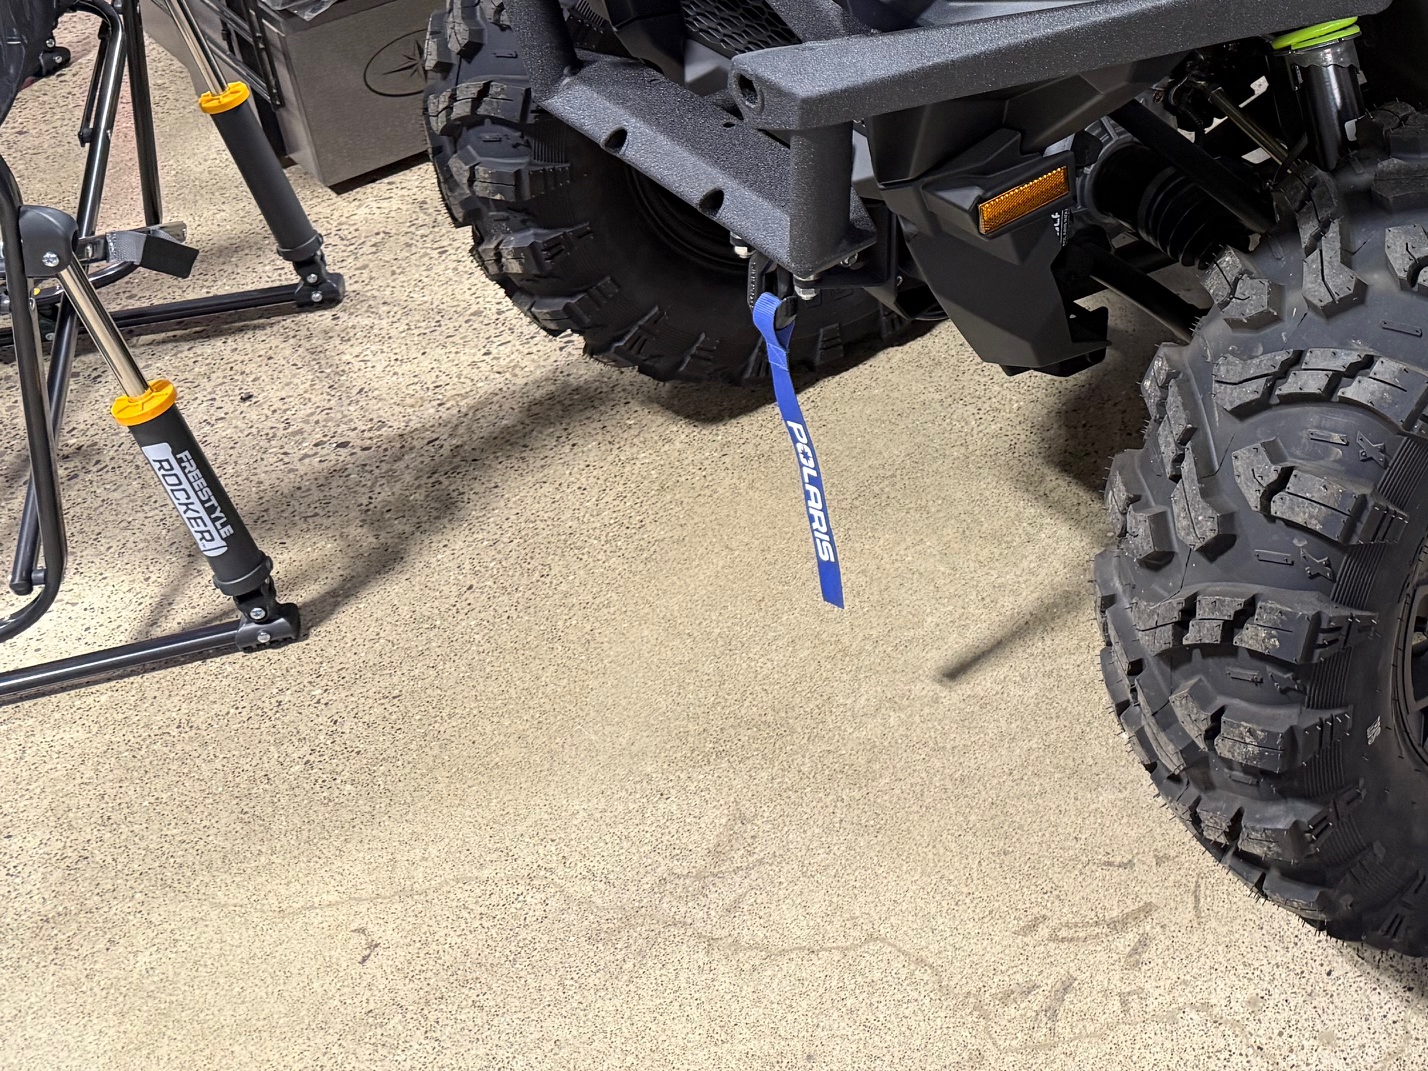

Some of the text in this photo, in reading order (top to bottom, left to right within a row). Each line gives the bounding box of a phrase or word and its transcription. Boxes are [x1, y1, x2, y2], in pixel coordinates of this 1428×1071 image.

[151, 458, 216, 543] ROCKER
[176, 449, 235, 539] FREESTYLE
[786, 420, 836, 563] POLARIS
